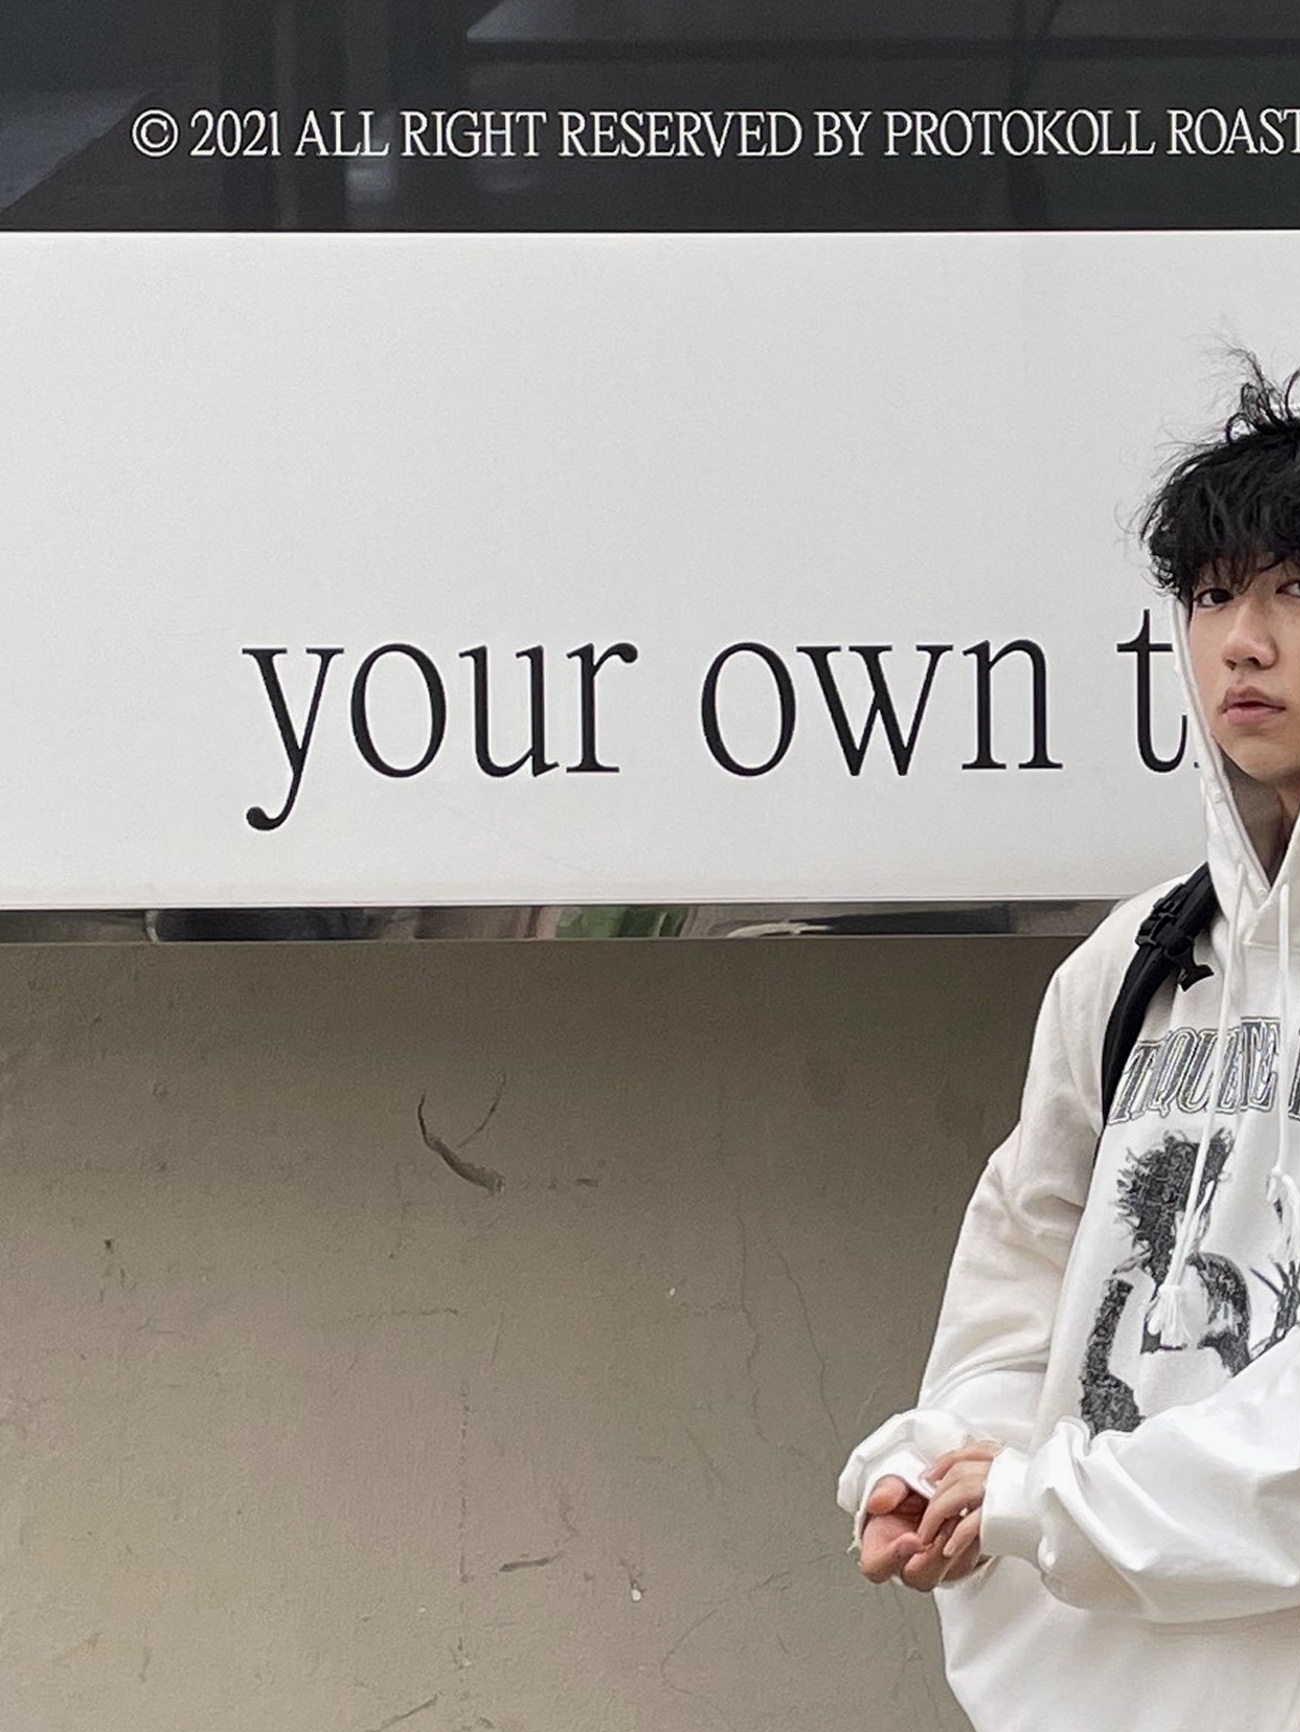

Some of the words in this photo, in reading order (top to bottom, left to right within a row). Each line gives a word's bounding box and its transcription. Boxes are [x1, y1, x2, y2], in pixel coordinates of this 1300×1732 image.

[190, 109, 281, 157] 2021
[294, 110, 390, 157] ALL
[400, 110, 547, 158] RIGHT
[558, 110, 802, 158] RESERVED
[813, 110, 872, 156] BY
[883, 109, 1156, 157] PROTOKOLL
[242, 642, 638, 831] your
[701, 639, 1063, 777] own
